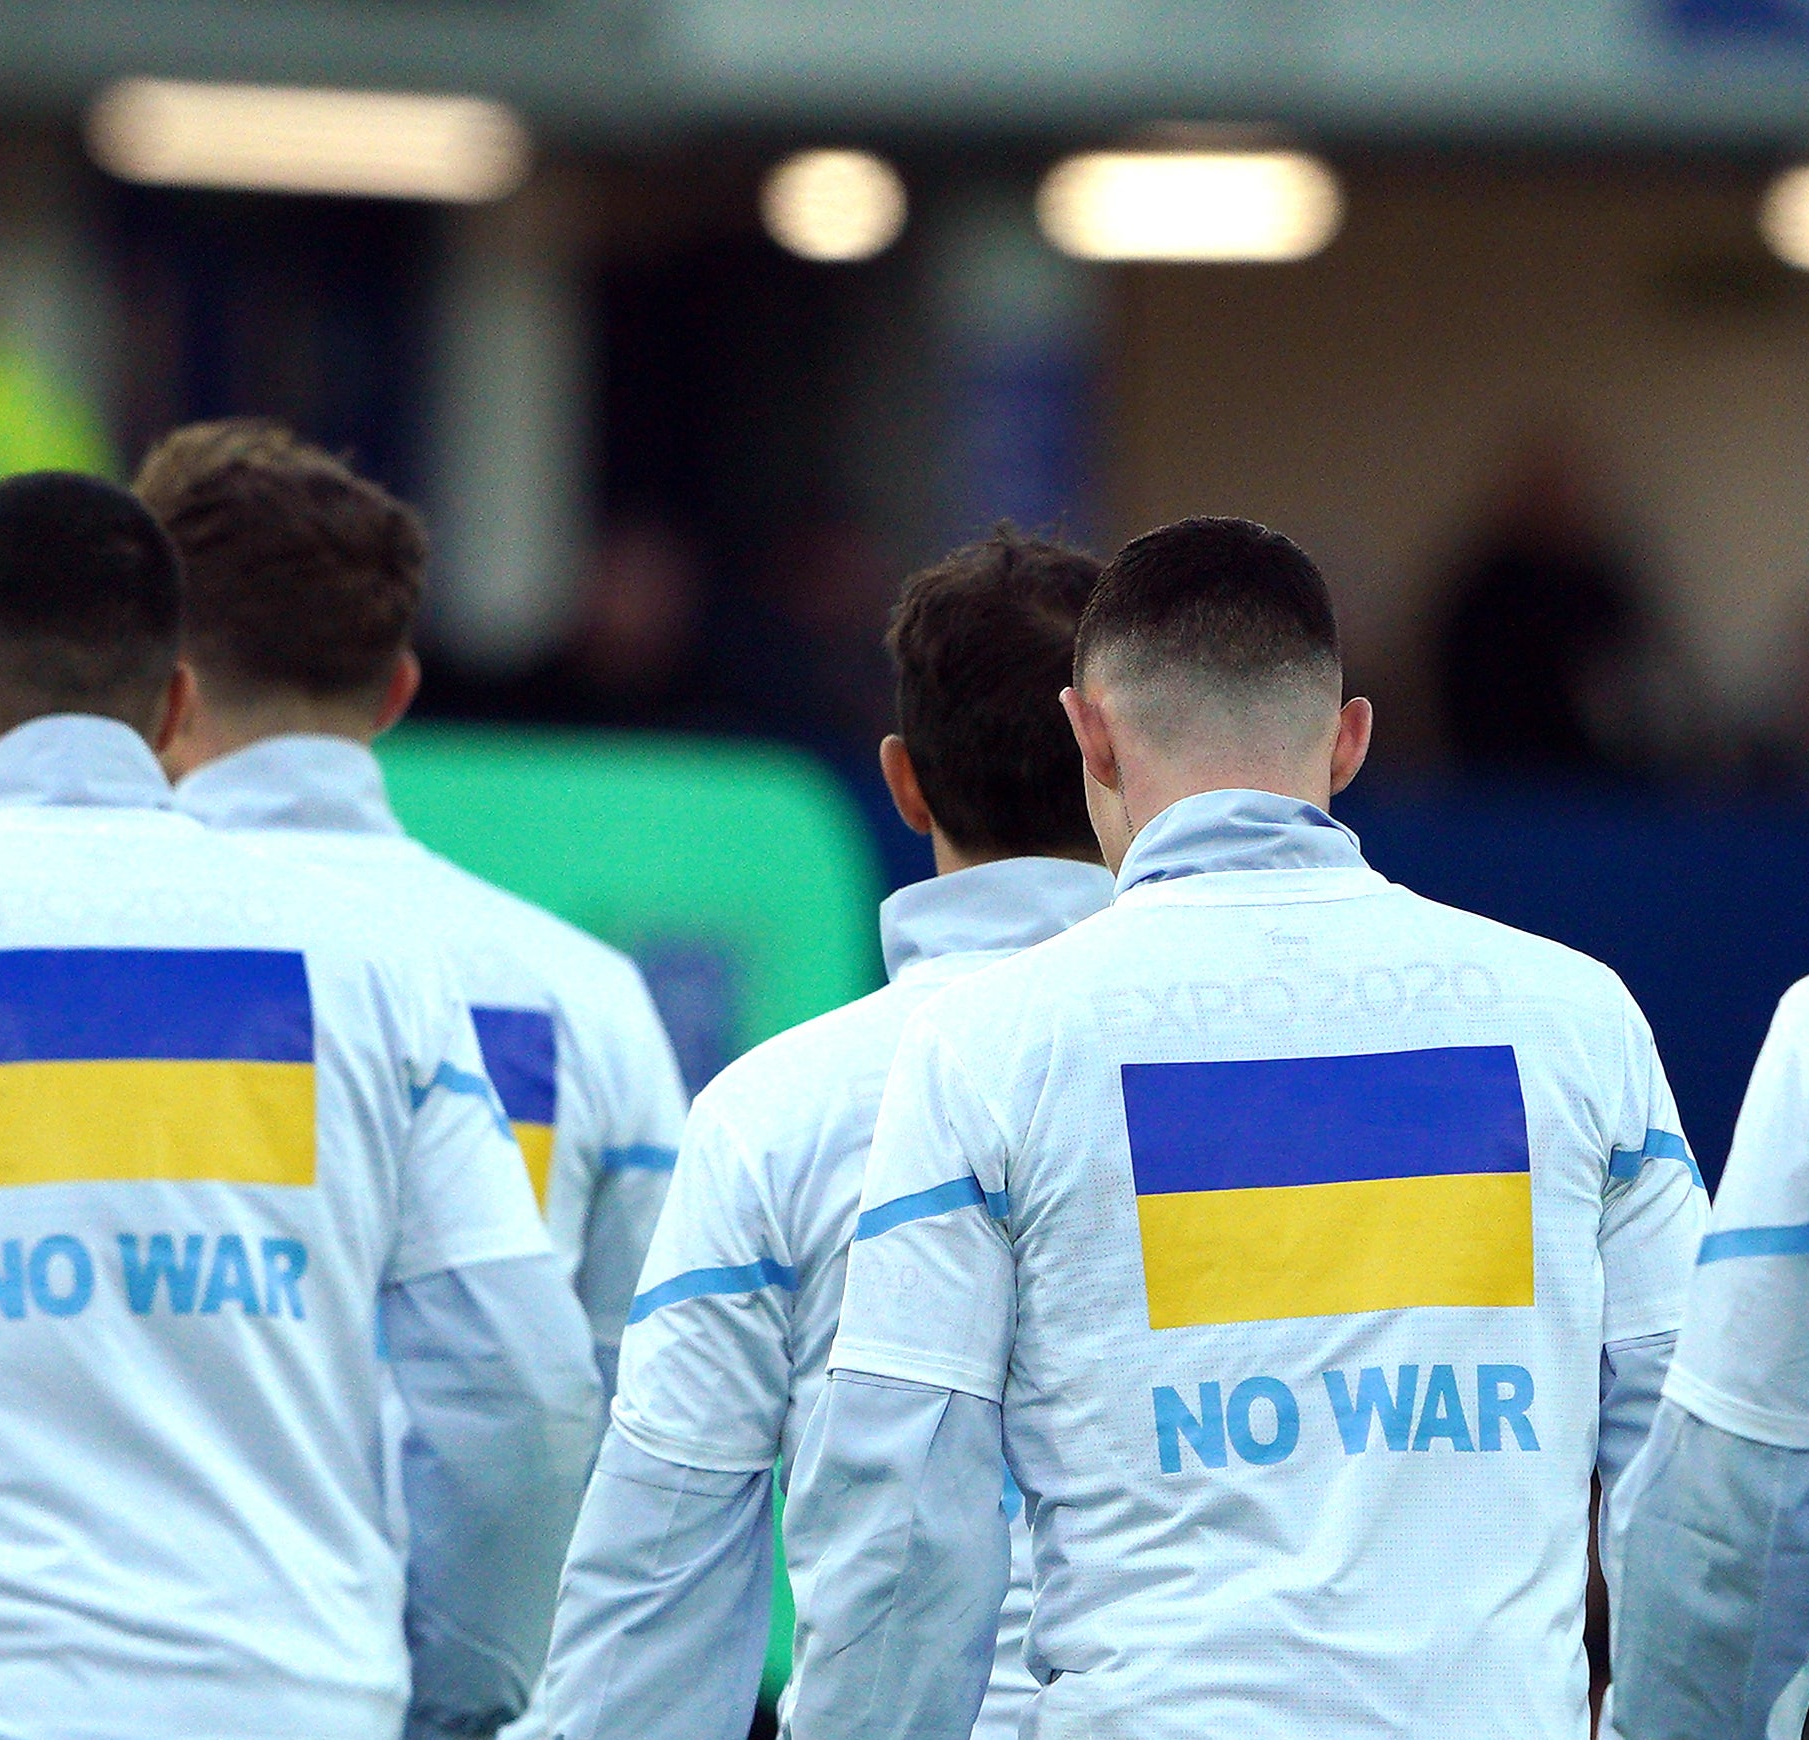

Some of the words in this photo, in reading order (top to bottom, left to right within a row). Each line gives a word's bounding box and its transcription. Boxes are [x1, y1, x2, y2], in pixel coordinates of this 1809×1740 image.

[1088, 974, 1300, 1041] EXPO
[1312, 959, 1503, 1021] 2020
[116, 1231, 309, 1321] WAR
[1151, 1374, 1302, 1475] NO
[1324, 1362, 1542, 1456] WAR
